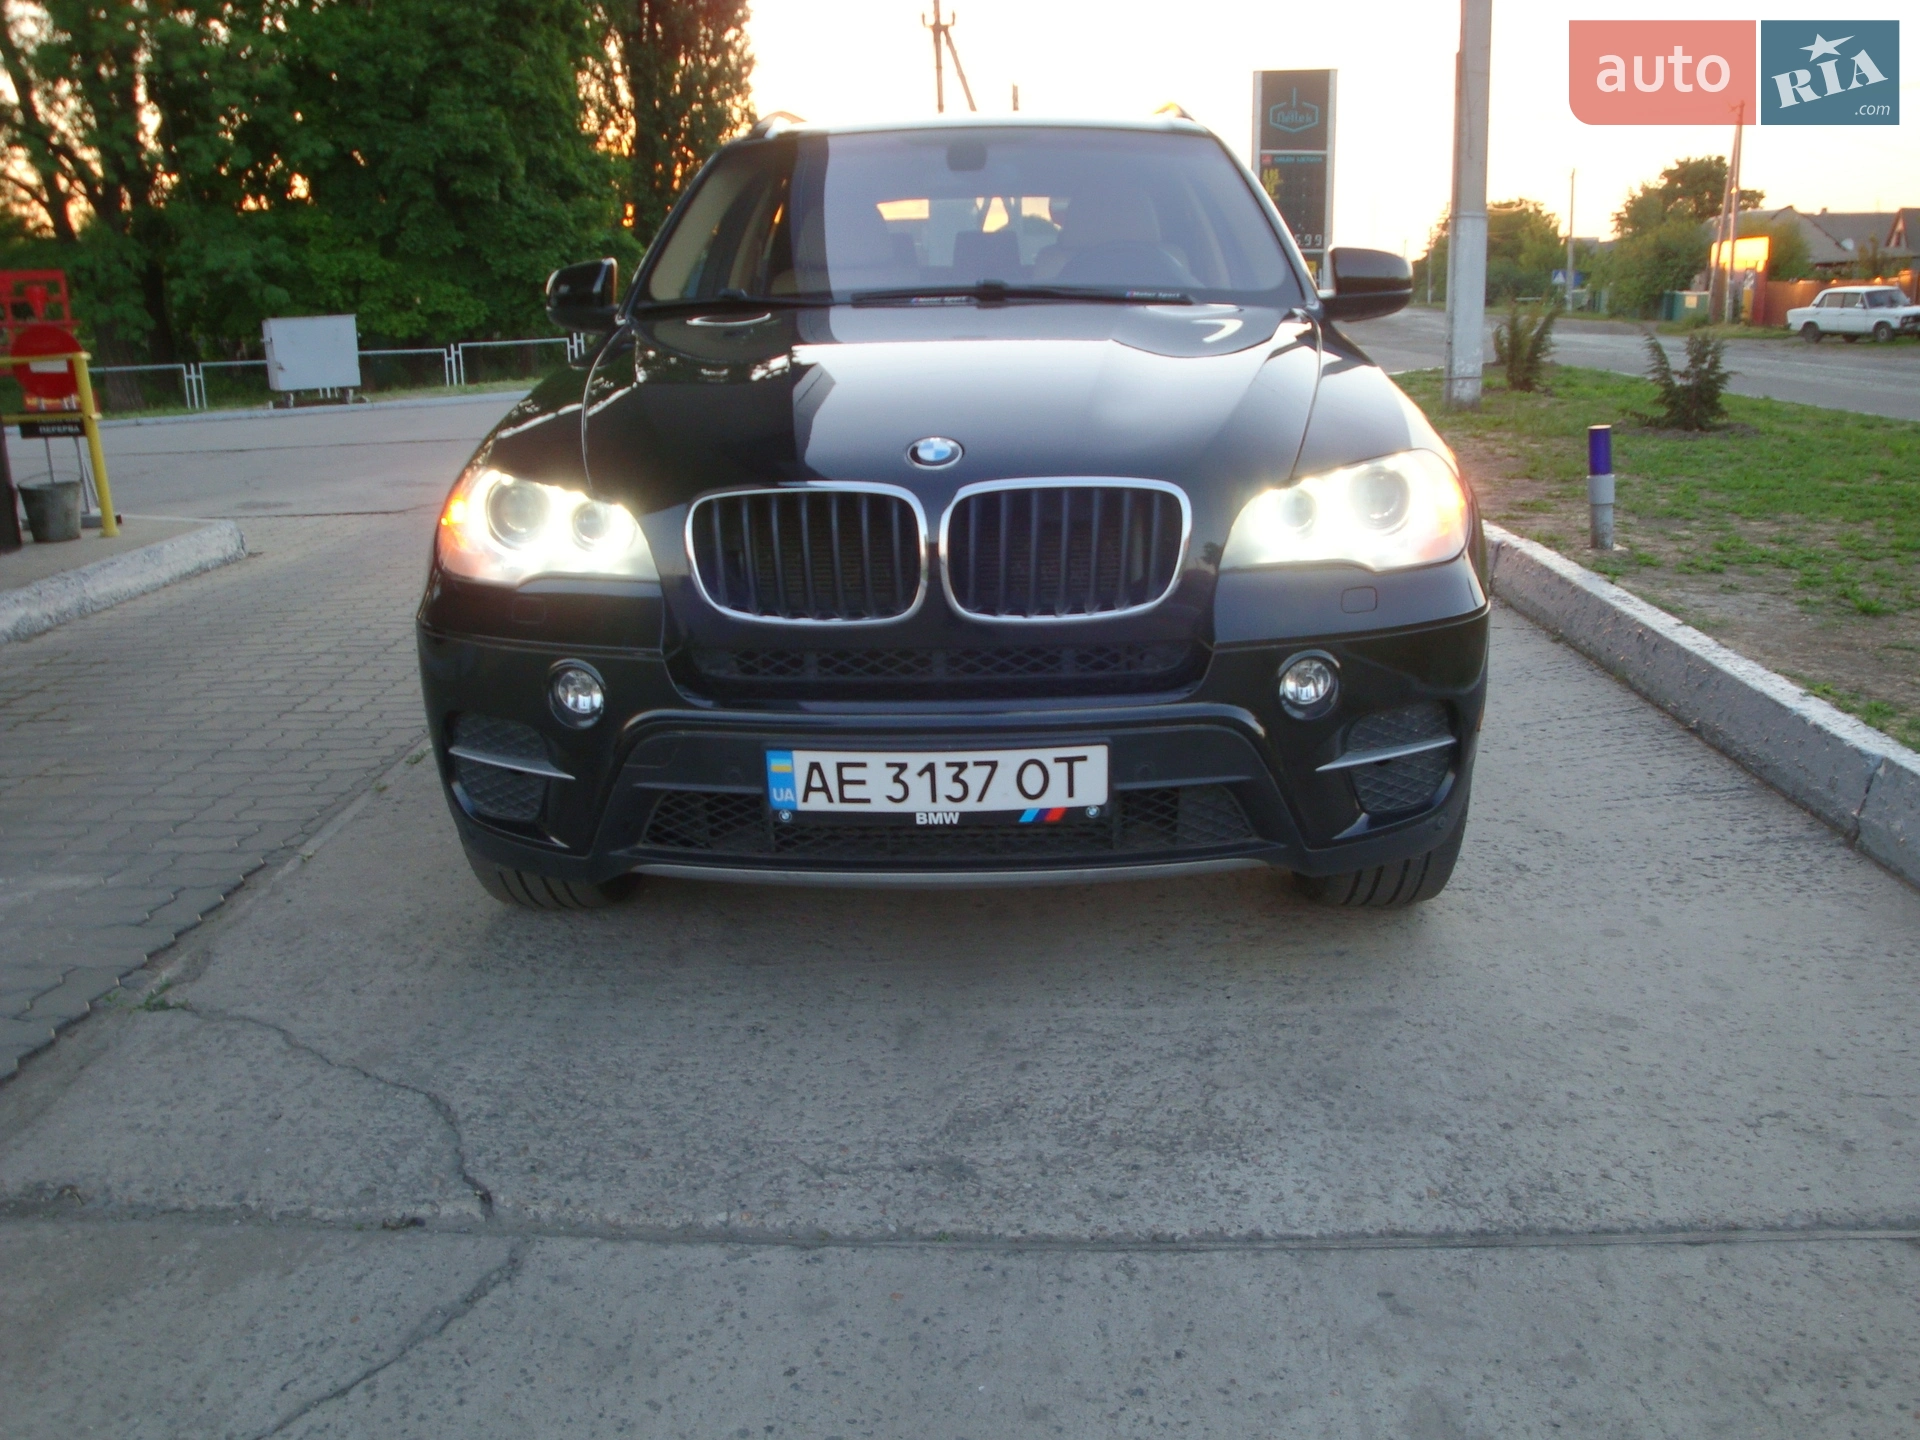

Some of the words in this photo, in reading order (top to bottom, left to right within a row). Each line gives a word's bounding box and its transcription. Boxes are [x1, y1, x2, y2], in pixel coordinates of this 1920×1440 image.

[802, 761, 872, 804] AE
[885, 760, 998, 804] 3137
[1016, 755, 1088, 801] OT
[773, 787, 795, 802] UA
[915, 812, 960, 826] BMW
